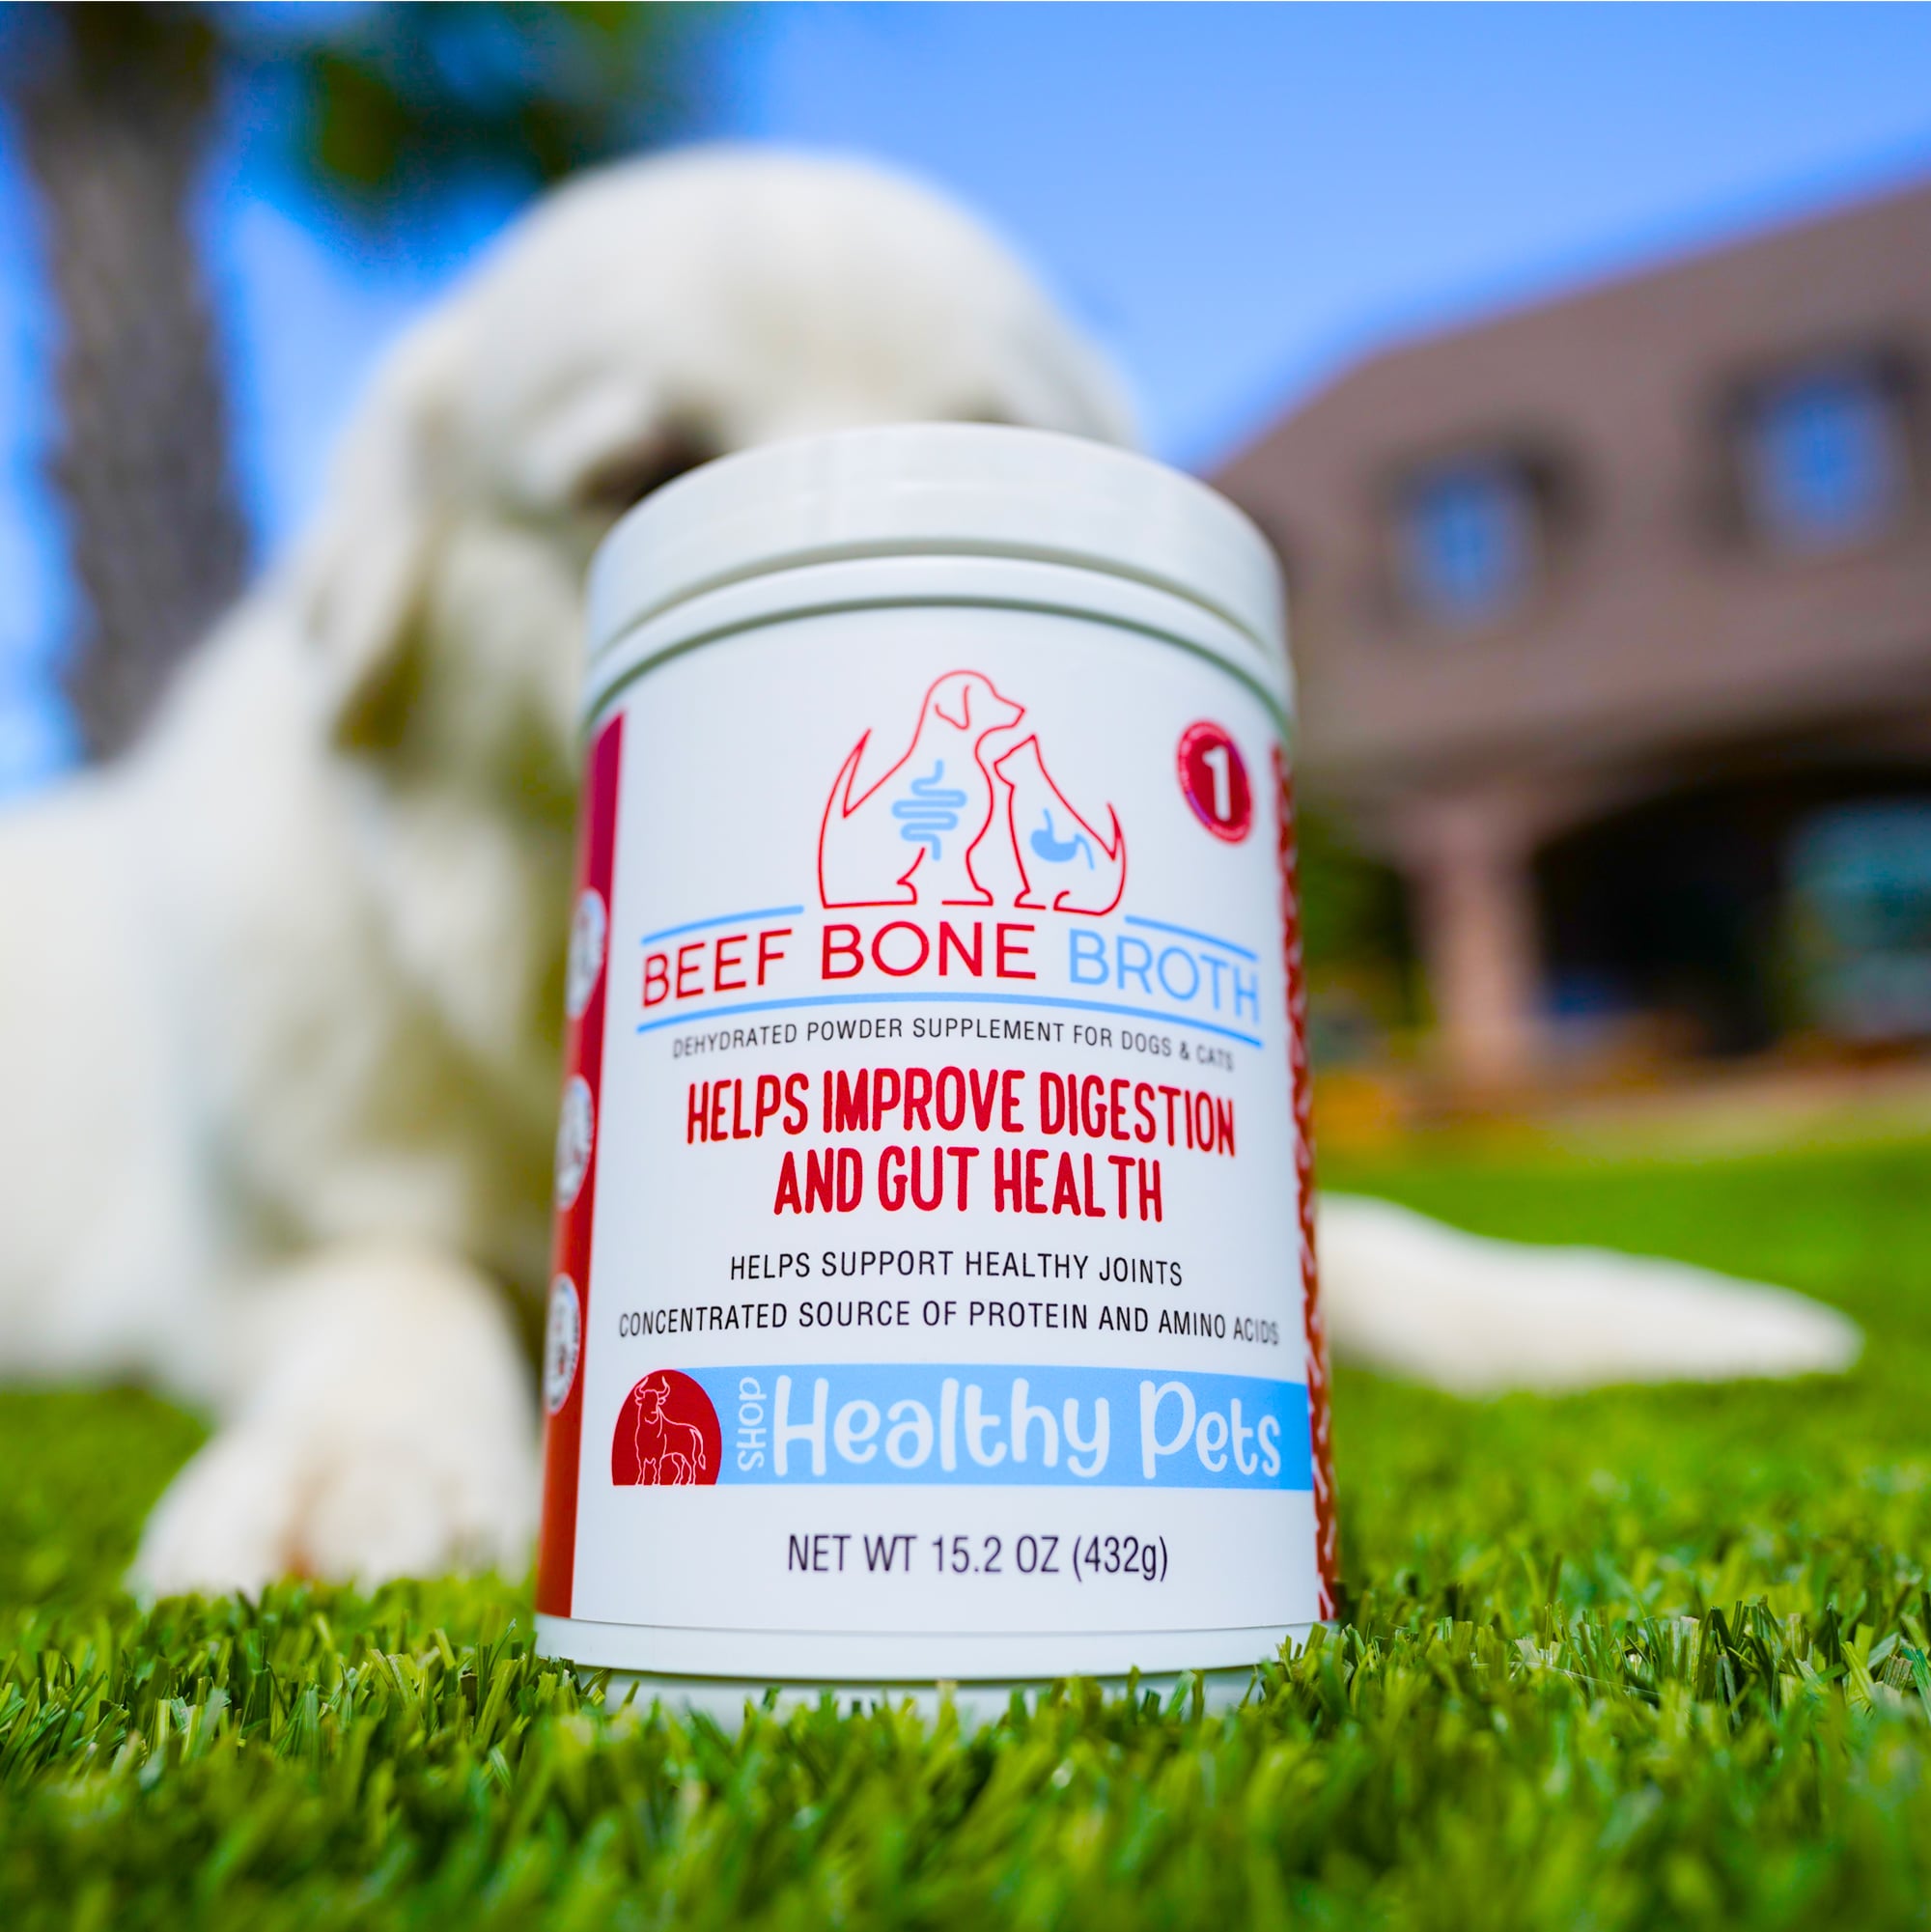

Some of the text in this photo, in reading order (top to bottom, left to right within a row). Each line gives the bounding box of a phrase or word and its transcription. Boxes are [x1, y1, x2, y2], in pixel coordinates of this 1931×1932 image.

[1202, 745, 1231, 822] 1
[643, 928, 793, 1008] BEEF
[821, 920, 1036, 980] BONE
[1070, 929, 1260, 1024] BROTH
[674, 1018, 1235, 1071] DEHYDRATED POWDER SUPPLEMENT FOR DOGS & CATS
[686, 1066, 1236, 1158] HELPS IMPROVE DIGESTION
[773, 1145, 1162, 1222] AND GUT HEALTH
[731, 1250, 1182, 1286] HELPS SUPPORT HEALTHY JOINTS
[620, 1301, 1278, 1345] CONCENTRATED SOURCE OF PROTEIN AND AMINO ACIDS
[738, 1378, 766, 1470] SHOP
[774, 1376, 1282, 1479] Healthy Pets
[789, 1534, 1167, 1582] NET WT 15.2 OZ (432g)
